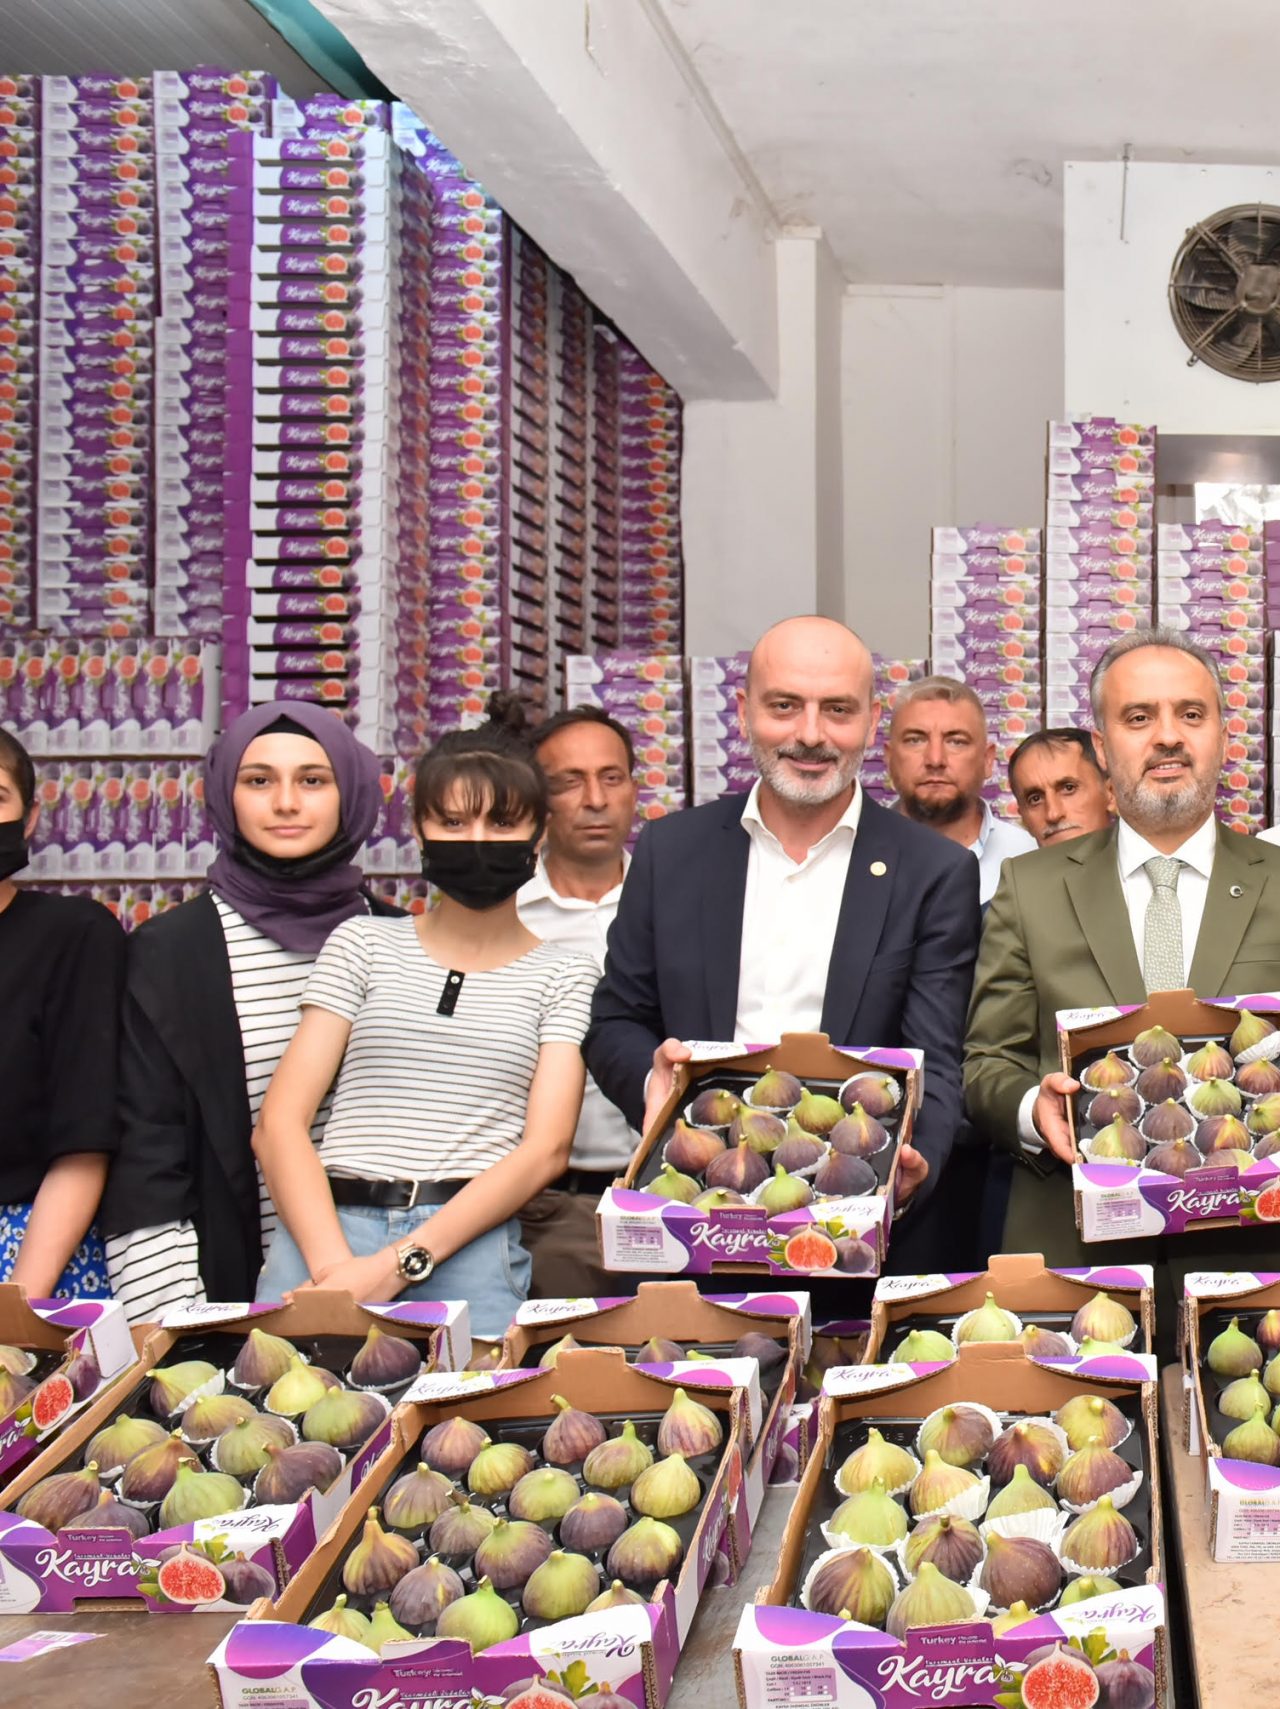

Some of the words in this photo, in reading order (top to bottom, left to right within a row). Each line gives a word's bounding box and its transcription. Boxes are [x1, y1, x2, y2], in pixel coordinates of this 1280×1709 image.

[1167, 1189, 1242, 1218] Kayra
[689, 1222, 771, 1255] Kayra
[67, 1534, 97, 1543] Turkey
[35, 1549, 137, 1587] Kayra
[1085, 1602, 1158, 1624] Kayra
[920, 1635, 957, 1646] Turkey
[877, 1654, 997, 1700] Kayra
